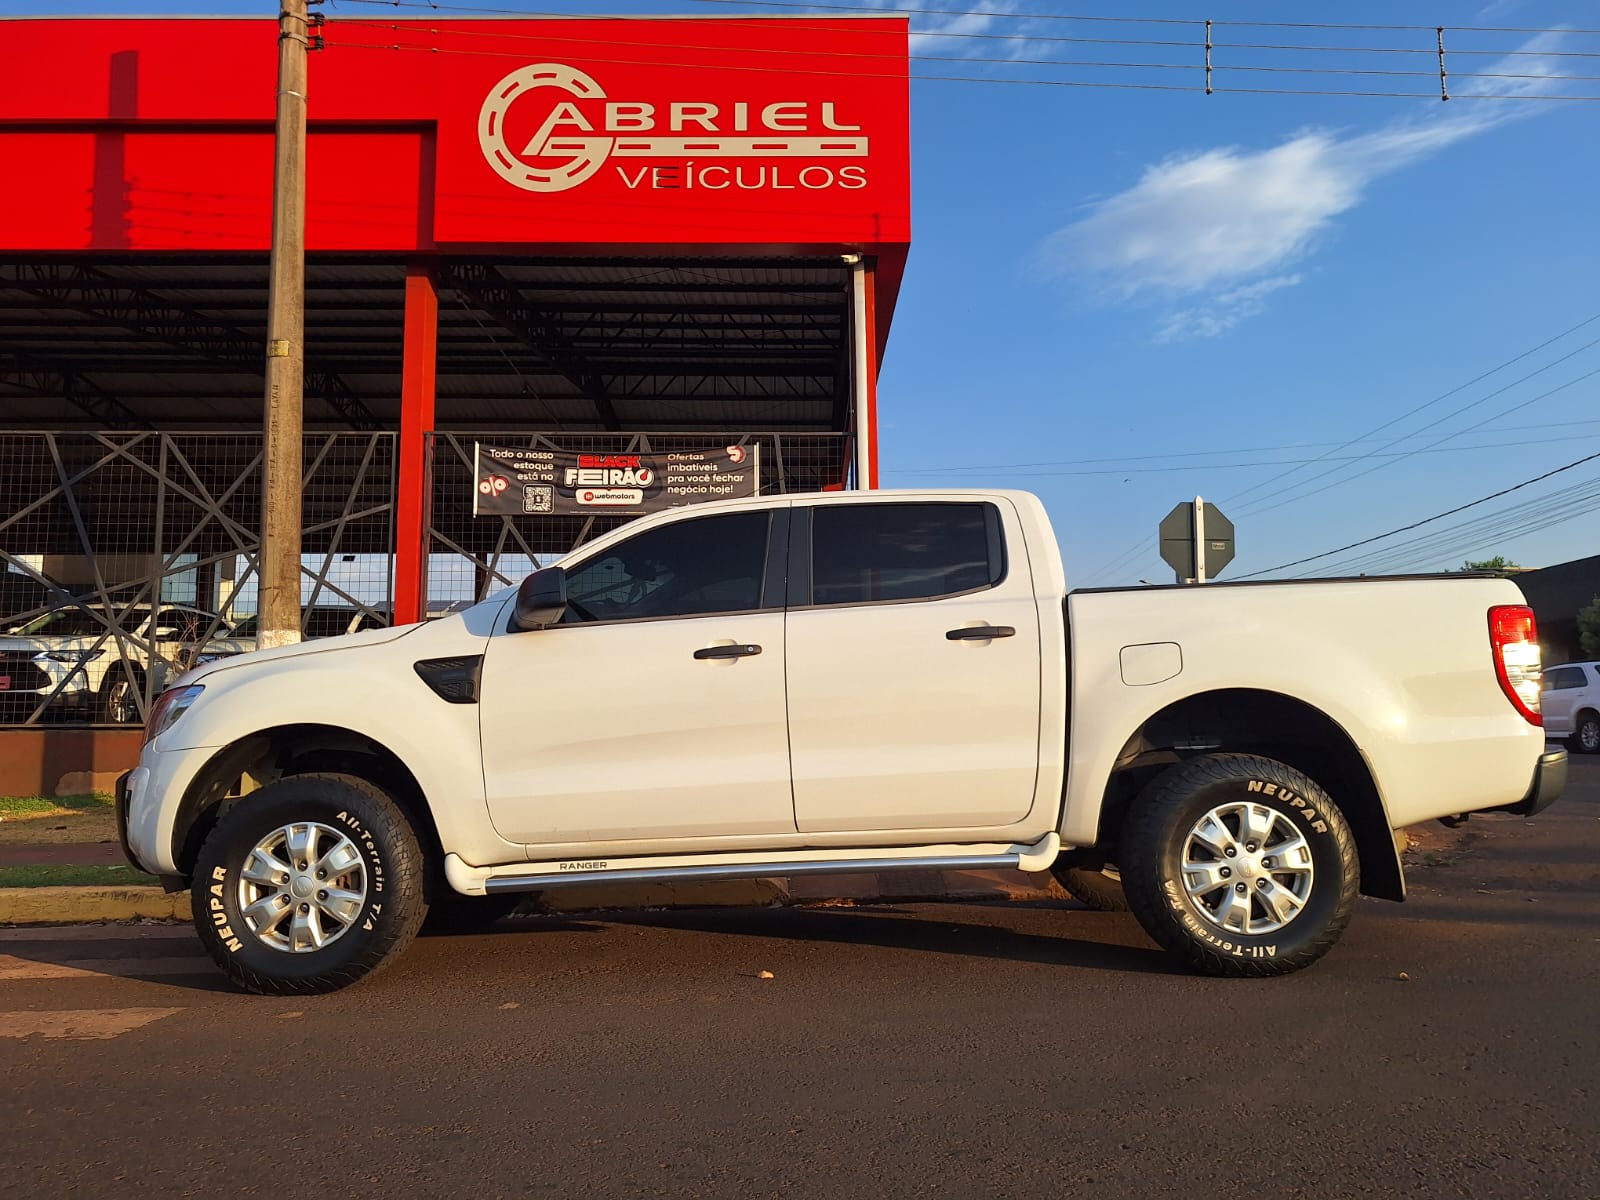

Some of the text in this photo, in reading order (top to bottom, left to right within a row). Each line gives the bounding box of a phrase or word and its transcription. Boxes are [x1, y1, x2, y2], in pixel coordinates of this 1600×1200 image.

[616, 161, 868, 189] VEÍCULOS
[489, 448, 514, 458] Todo
[667, 453, 704, 461] Ofertas
[513, 462, 554, 471] estoque
[578, 455, 640, 467] BLACK
[667, 462, 718, 472] imbatíveis
[517, 471, 539, 480] está
[565, 467, 653, 486] FEIRÃO
[667, 473, 744, 484] pra você fechar
[667, 484, 734, 495] negócio hoje!
[1247, 780, 1328, 834] NEUPAR
[336, 809, 384, 932] All-Terrain T/A
[559, 861, 608, 871] RANGER
[210, 865, 244, 953] NEUPAR
